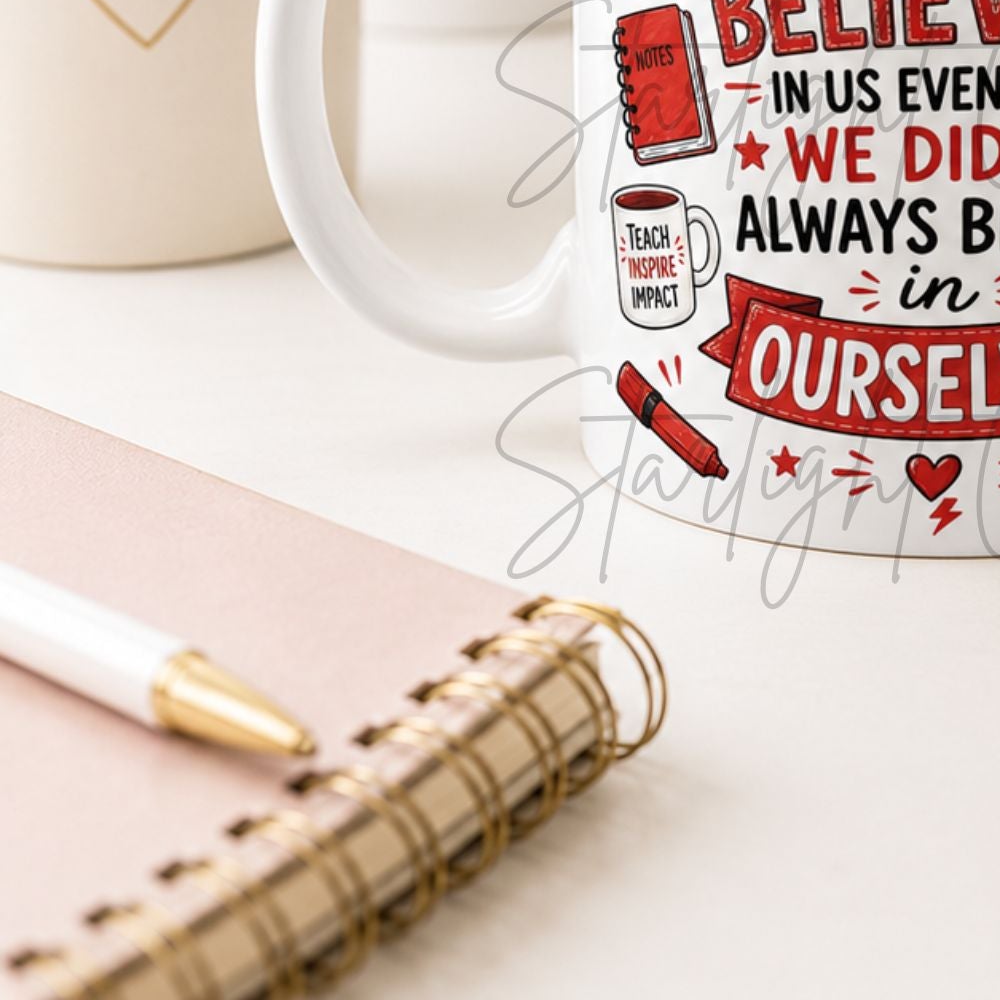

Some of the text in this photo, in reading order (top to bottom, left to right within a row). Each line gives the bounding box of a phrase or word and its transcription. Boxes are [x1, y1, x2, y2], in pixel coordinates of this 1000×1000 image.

[635, 44, 675, 72] NOTES
[772, 68, 809, 114] IN
[824, 67, 881, 113] US
[784, 125, 877, 184] WE
[735, 196, 938, 254] ALWAYS
[627, 255, 678, 280] INSPIRE
[898, 264, 980, 313] in
[631, 284, 679, 310] IMPACT
